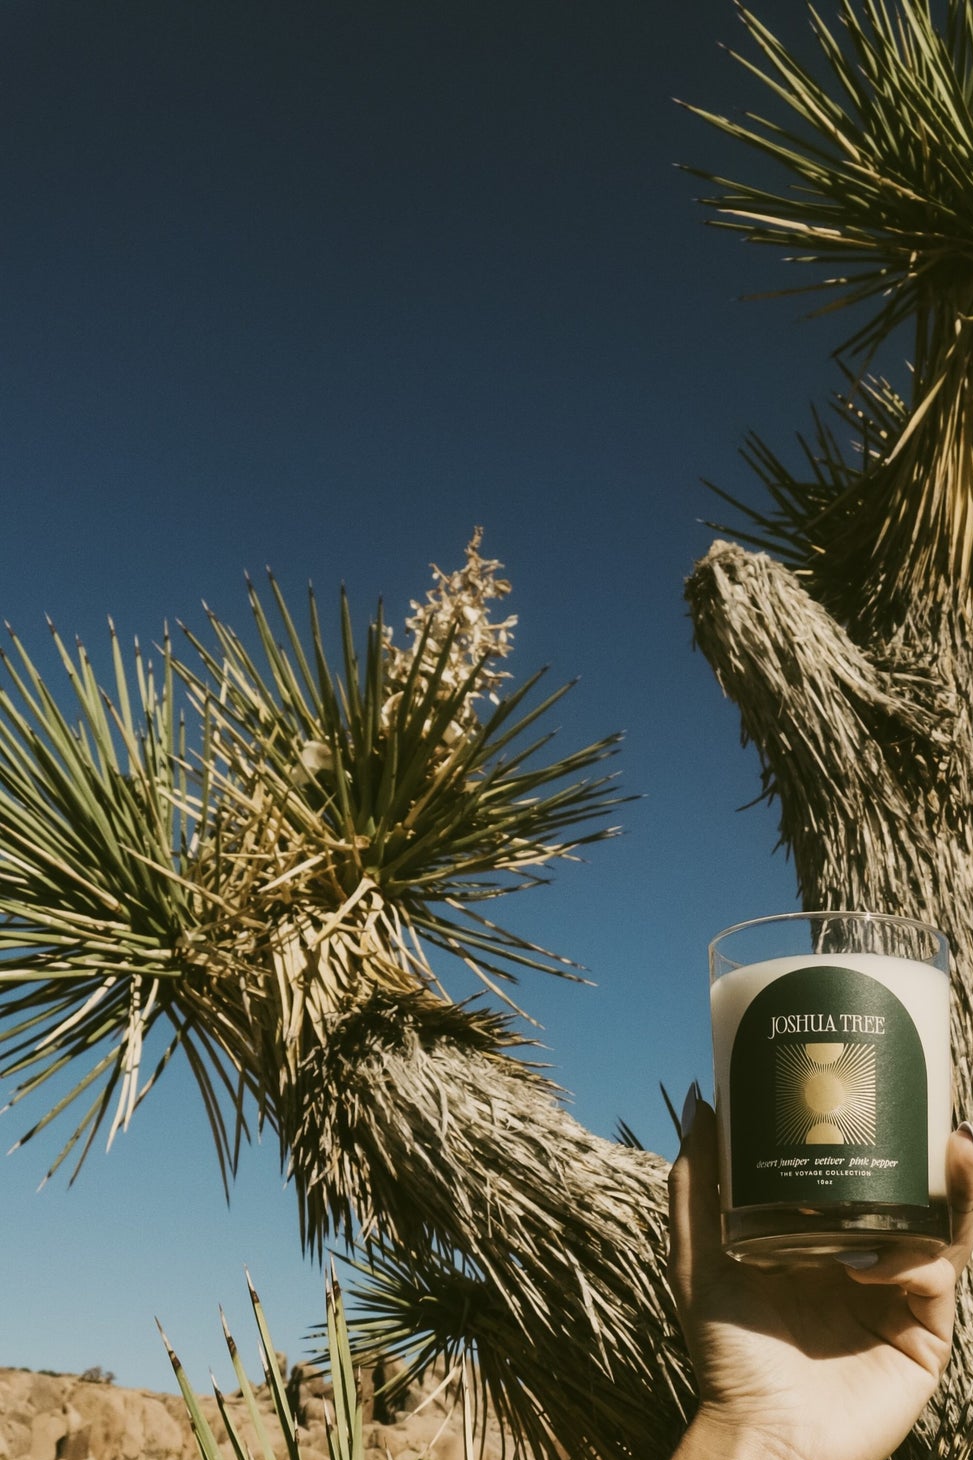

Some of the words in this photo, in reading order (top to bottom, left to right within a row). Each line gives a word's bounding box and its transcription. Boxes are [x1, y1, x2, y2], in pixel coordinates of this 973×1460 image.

[768, 1014, 837, 1039] JOSHUA
[840, 1014, 885, 1034] TREE
[756, 1159, 777, 1168] desert
[778, 1157, 810, 1168] juniper
[814, 1156, 845, 1166] vetiver
[849, 1156, 870, 1167] pink
[870, 1158, 898, 1168] pepper
